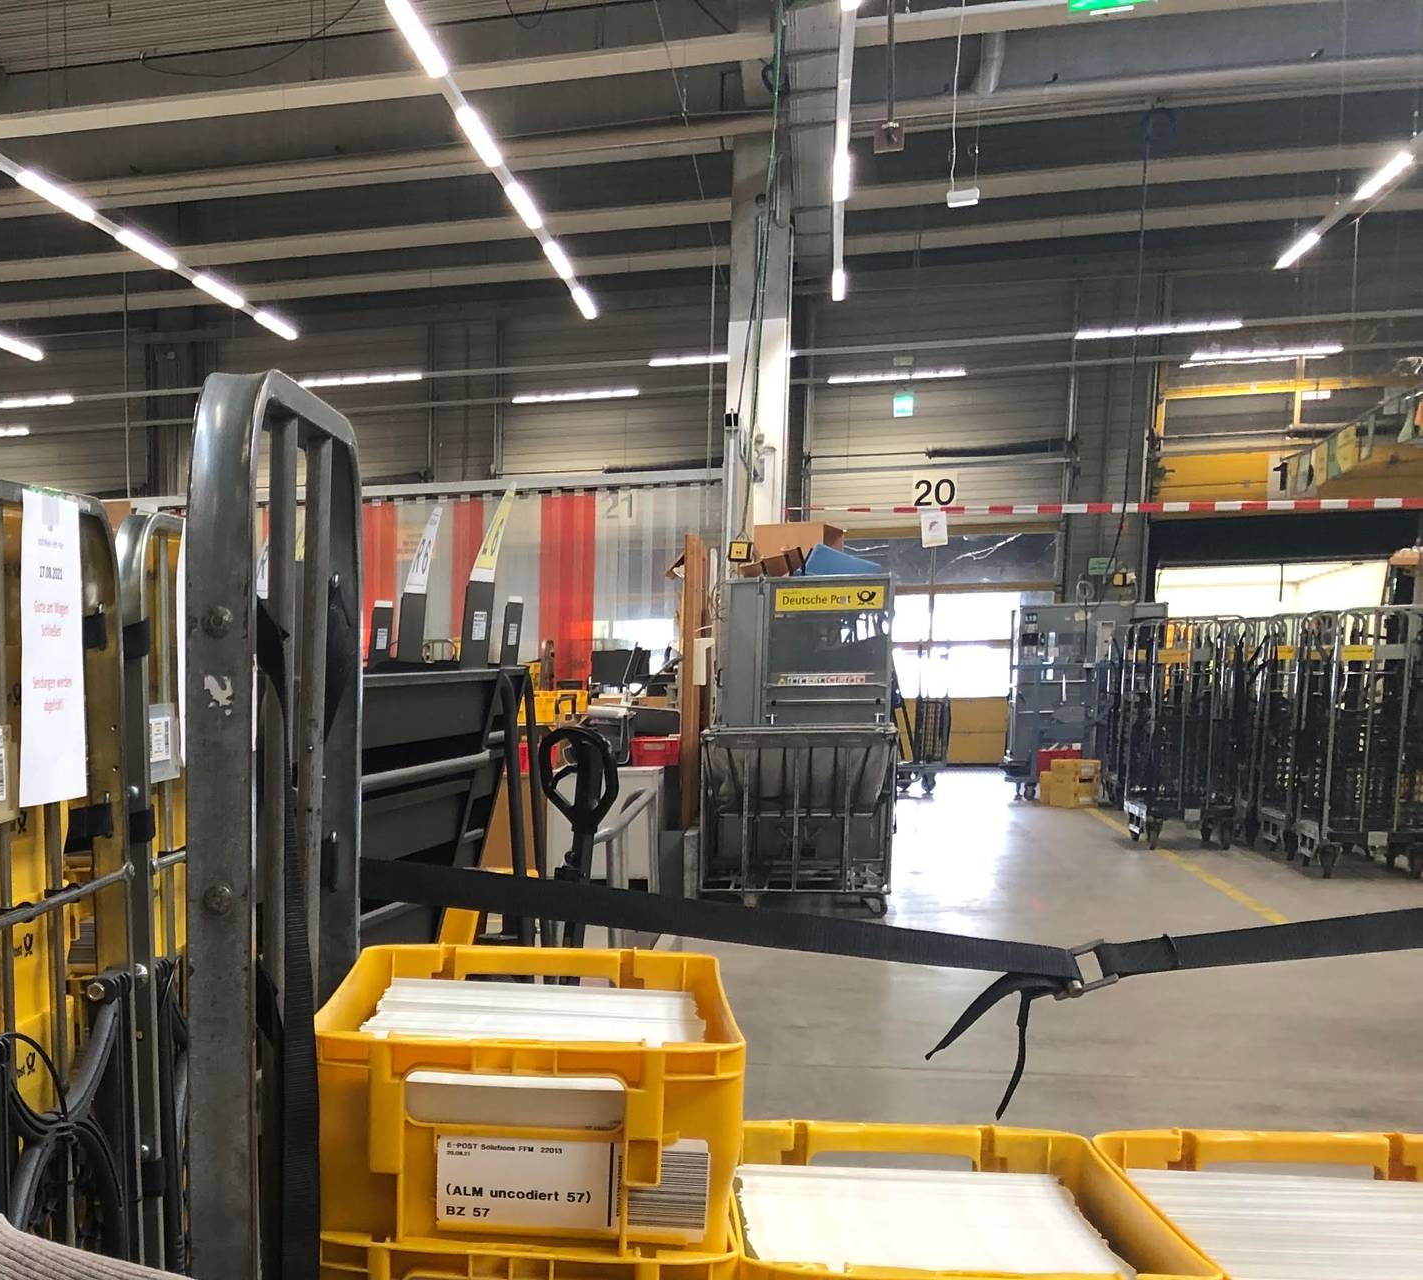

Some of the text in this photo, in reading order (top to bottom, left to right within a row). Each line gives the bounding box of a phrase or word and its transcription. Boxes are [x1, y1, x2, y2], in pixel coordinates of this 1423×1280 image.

[913, 478, 956, 507] 20
[601, 491, 633, 519] 21
[782, 594, 828, 606] Deutsche
[446, 1141, 563, 1155] E-POST Solutions FFM 22013
[445, 1182, 592, 1204] (ALM uncodiert 57)
[445, 1205, 490, 1218] BZ 57
